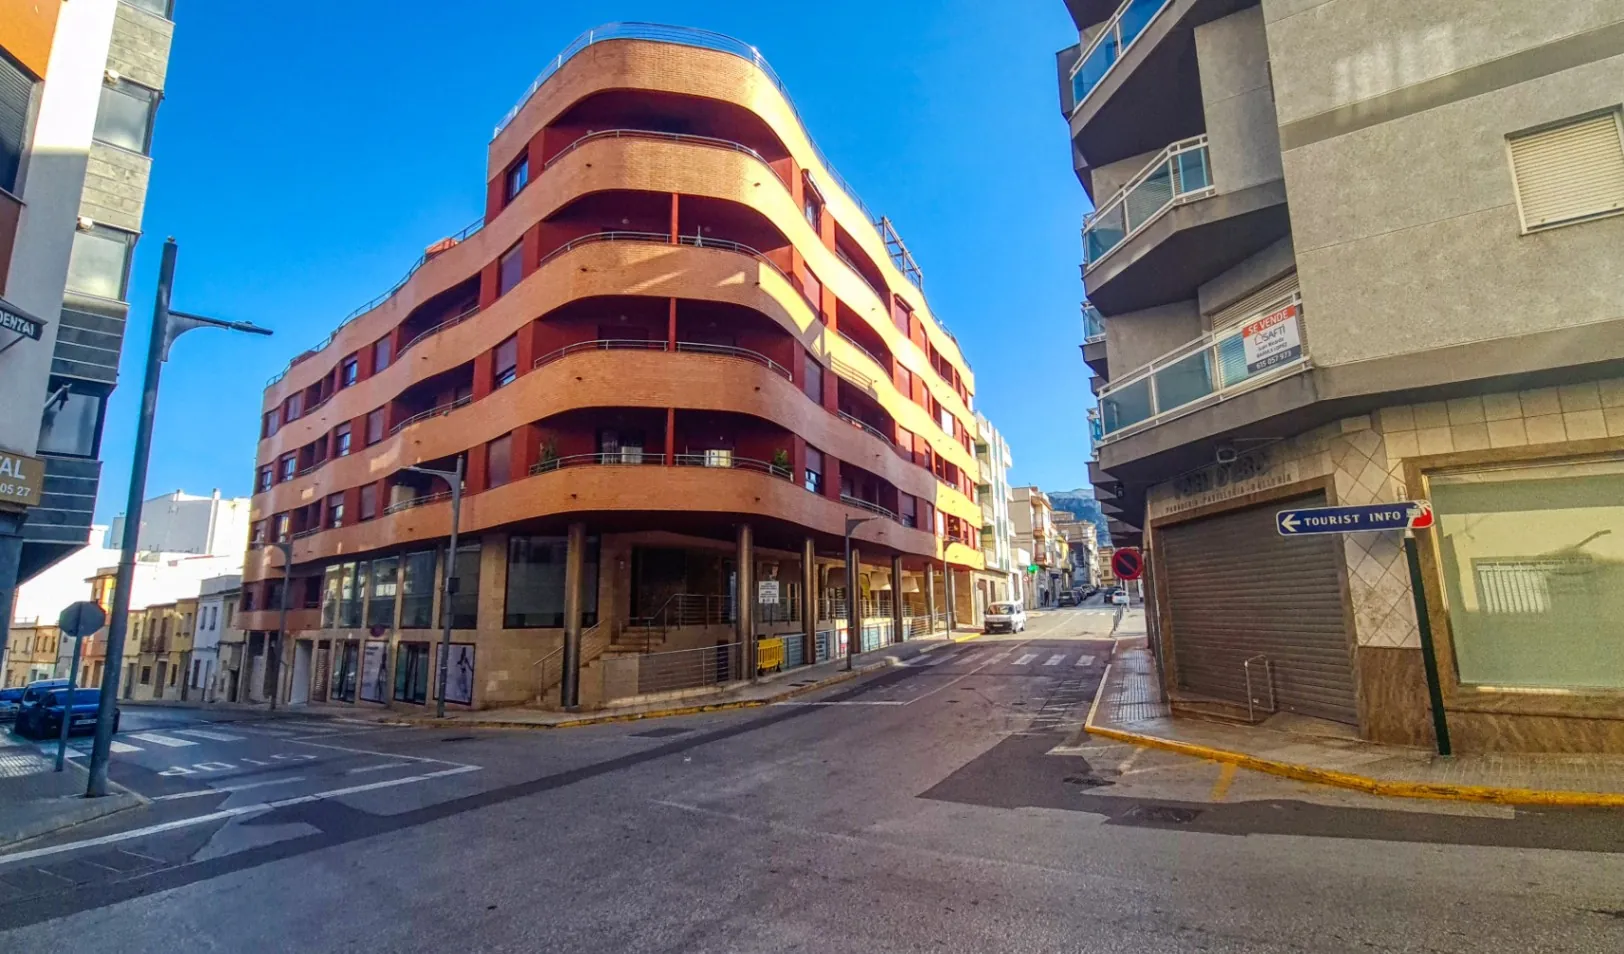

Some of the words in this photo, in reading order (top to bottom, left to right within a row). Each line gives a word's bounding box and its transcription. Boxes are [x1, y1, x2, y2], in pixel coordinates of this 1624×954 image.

[1248, 323, 1259, 334] SE
[1260, 309, 1288, 330] VENDE
[0, 455, 26, 480] AL
[0, 483, 14, 495] 05
[17, 486, 31, 497] 27
[1304, 514, 1360, 526] TOURIST
[1369, 511, 1401, 522] INFO
